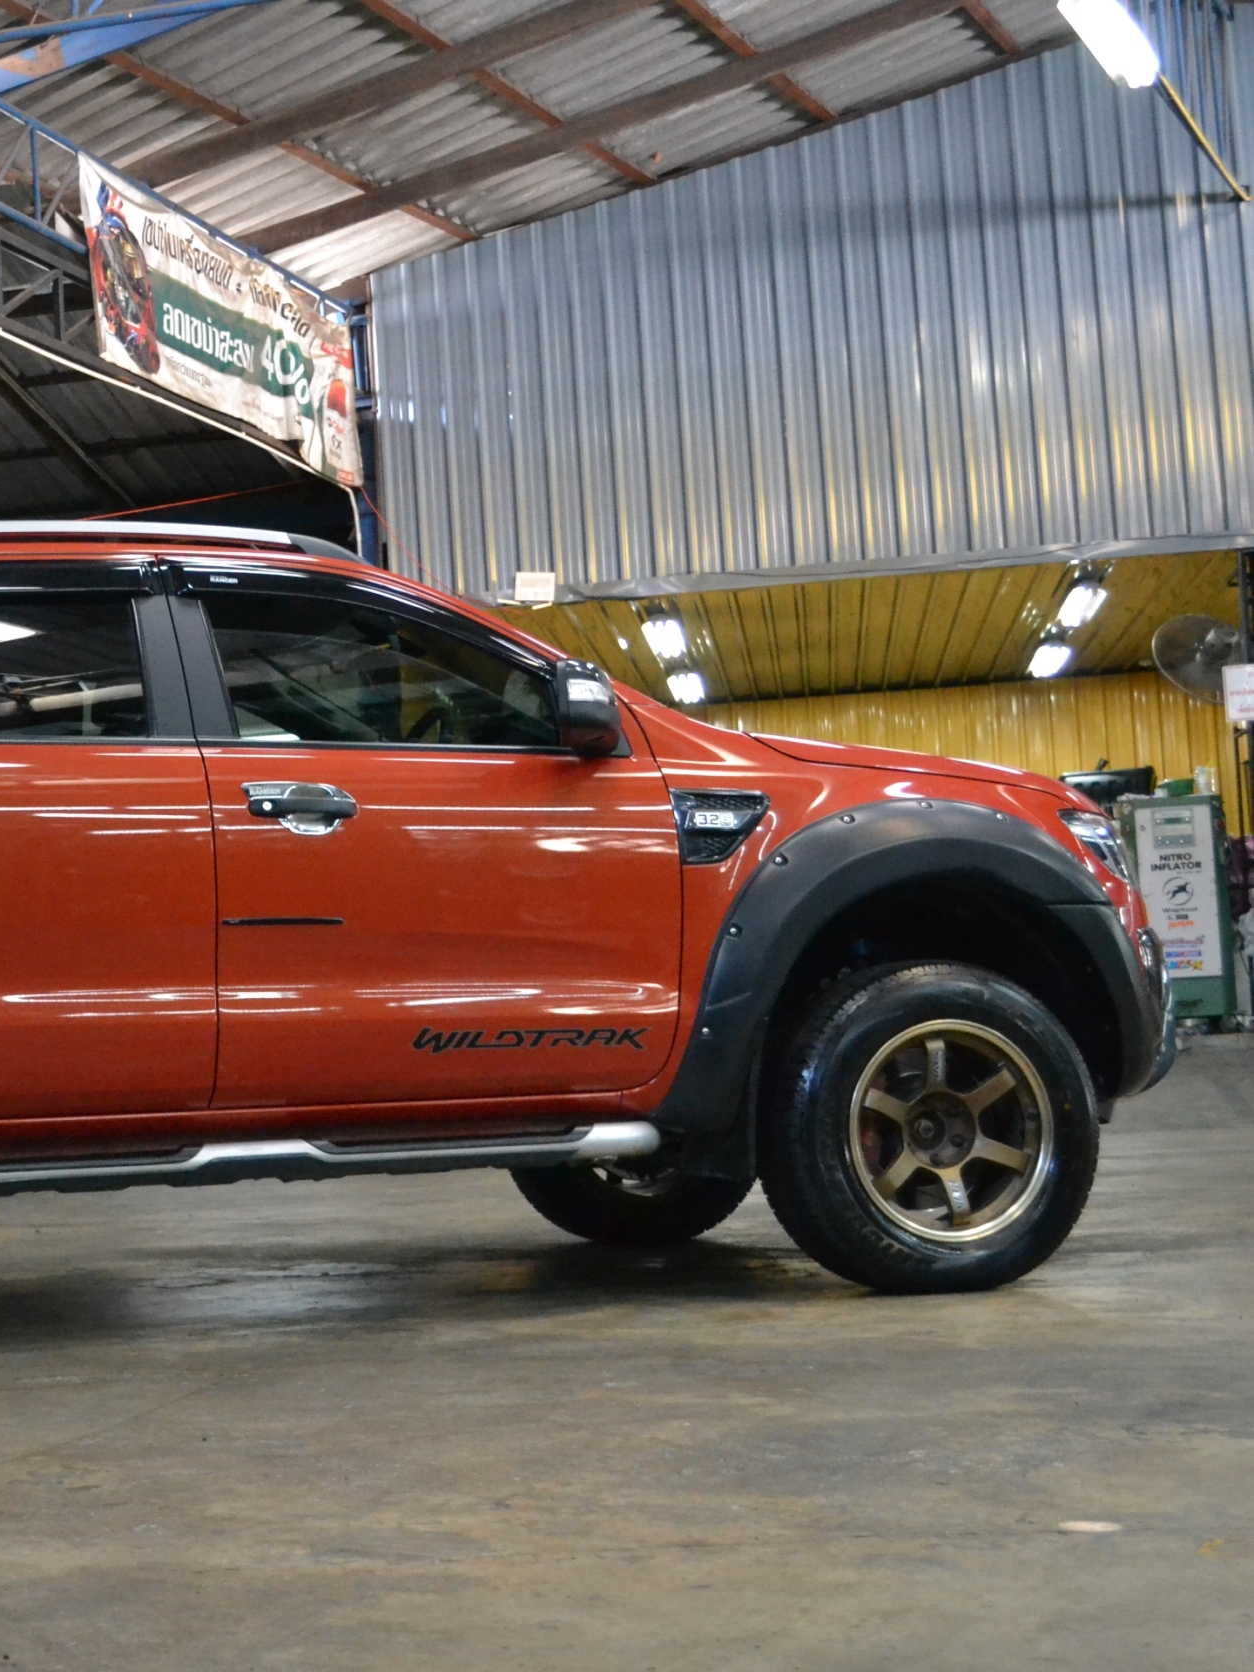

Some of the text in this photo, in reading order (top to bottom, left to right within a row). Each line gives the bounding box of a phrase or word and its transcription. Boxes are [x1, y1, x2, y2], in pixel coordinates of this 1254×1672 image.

[1159, 853, 1192, 861] NITRO
[1151, 861, 1202, 871] INFLATOR
[412, 1027, 651, 1054] WILDTRAK
